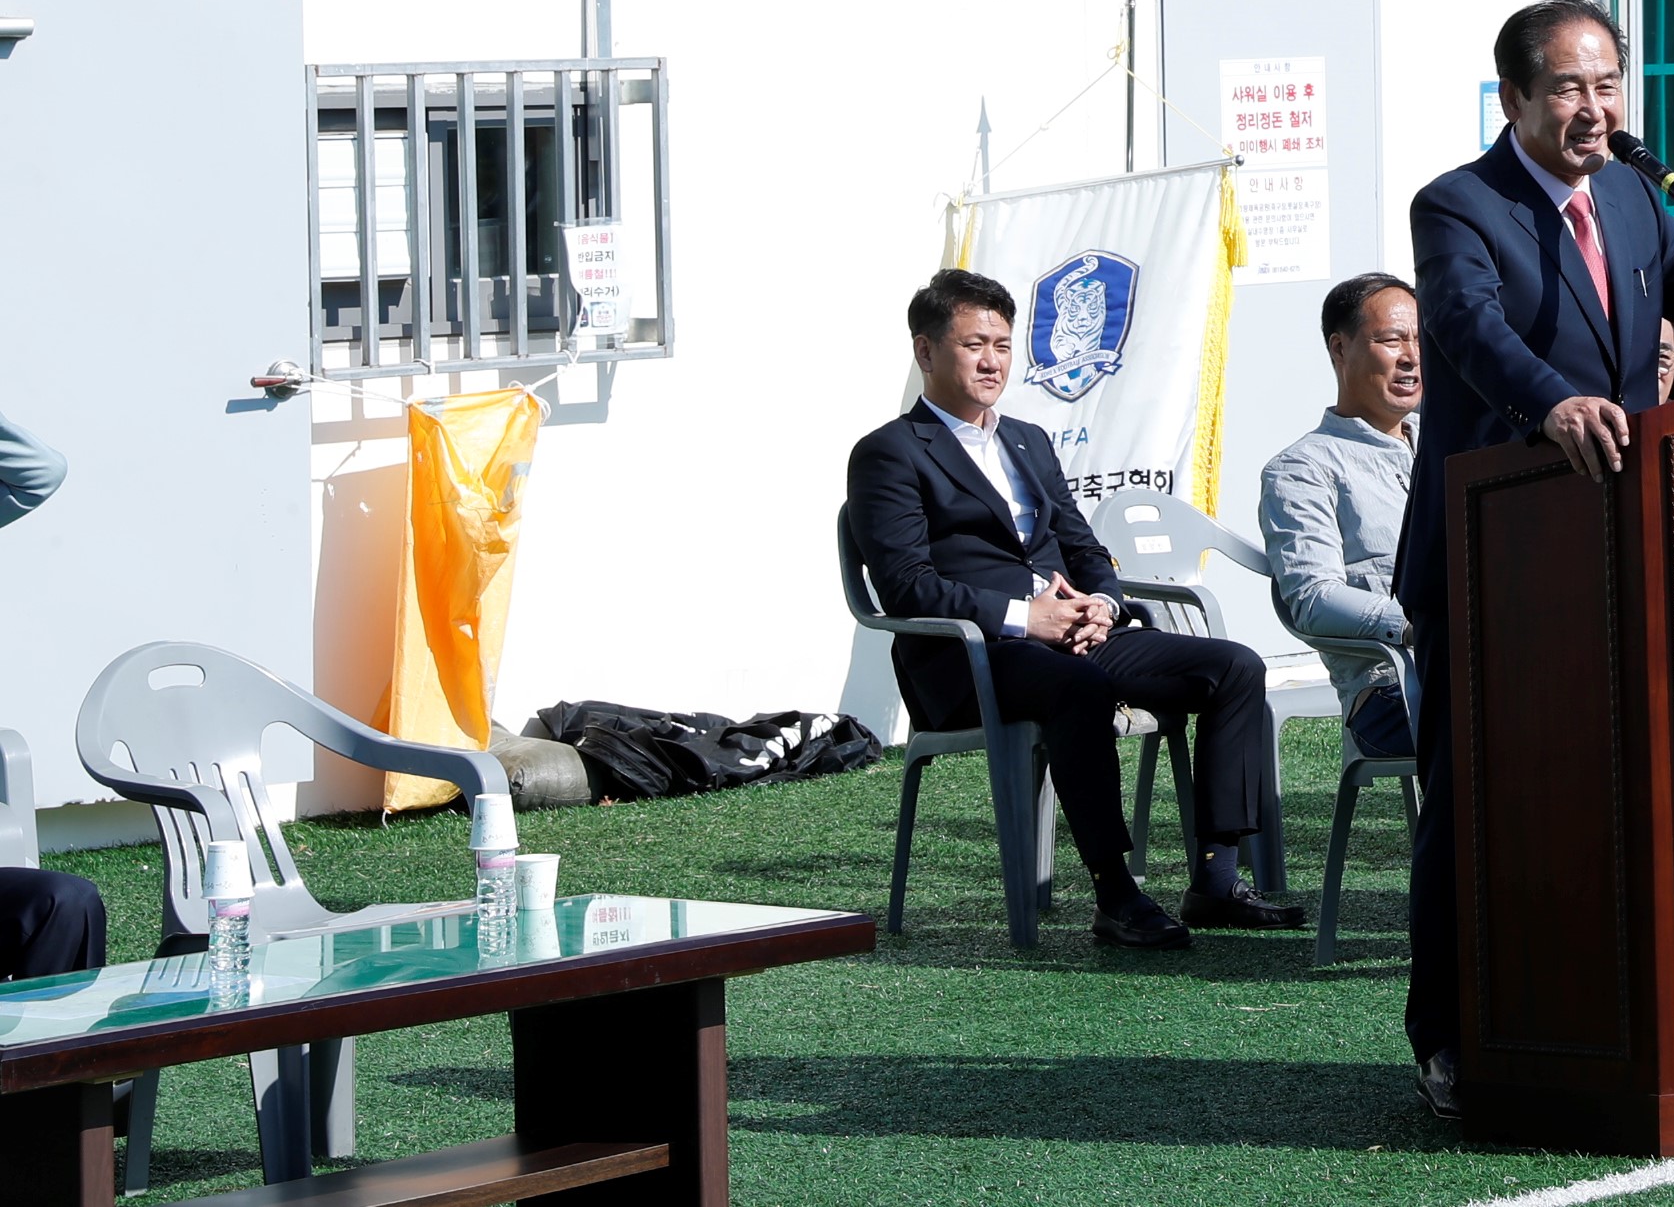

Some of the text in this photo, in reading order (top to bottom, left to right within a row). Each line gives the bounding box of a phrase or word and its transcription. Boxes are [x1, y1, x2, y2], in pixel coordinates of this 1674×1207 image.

[1232, 82, 1315, 104] 샤워실 이용 후
[1236, 110, 1312, 131] 정리정돈 철저
[1239, 136, 1324, 154] 미이행시 폐쇄 조치
[577, 250, 615, 263] 반입금지
